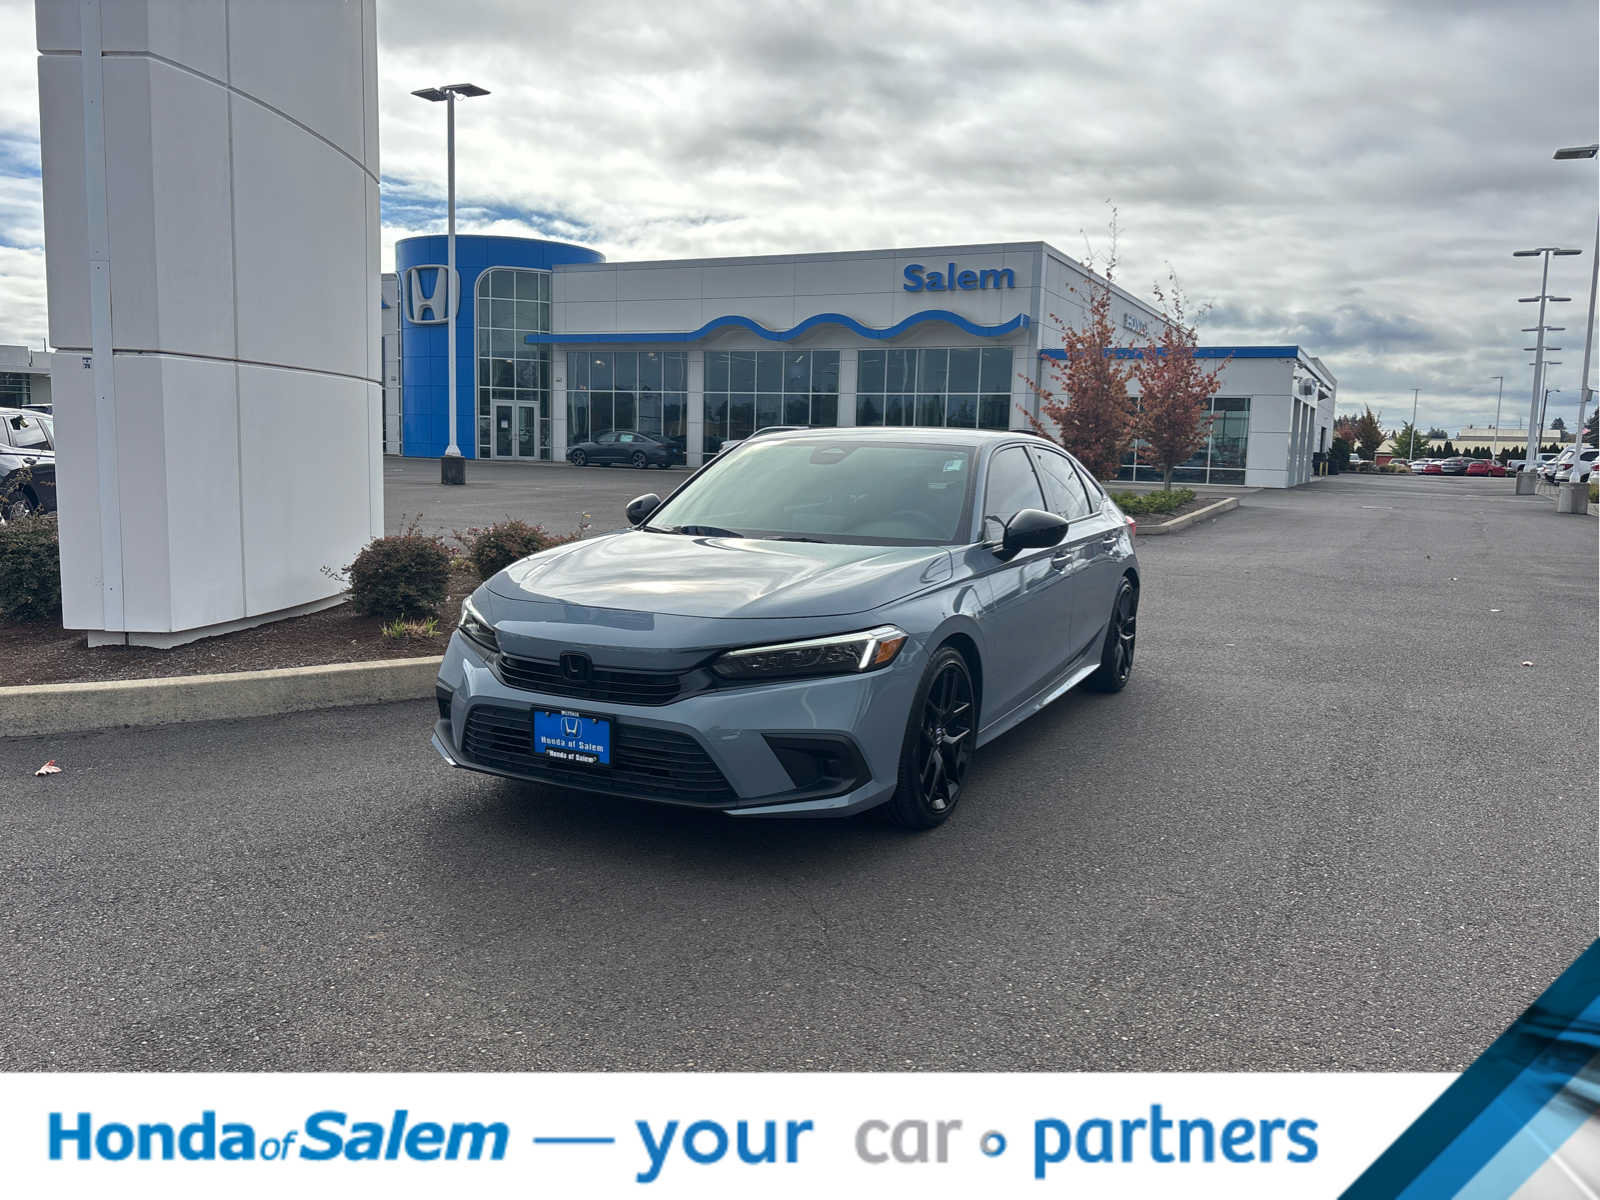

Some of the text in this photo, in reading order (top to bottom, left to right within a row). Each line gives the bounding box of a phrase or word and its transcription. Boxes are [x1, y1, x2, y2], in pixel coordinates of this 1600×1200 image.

[903, 263, 1016, 292] Salem
[541, 736, 604, 752] Honda of Salem
